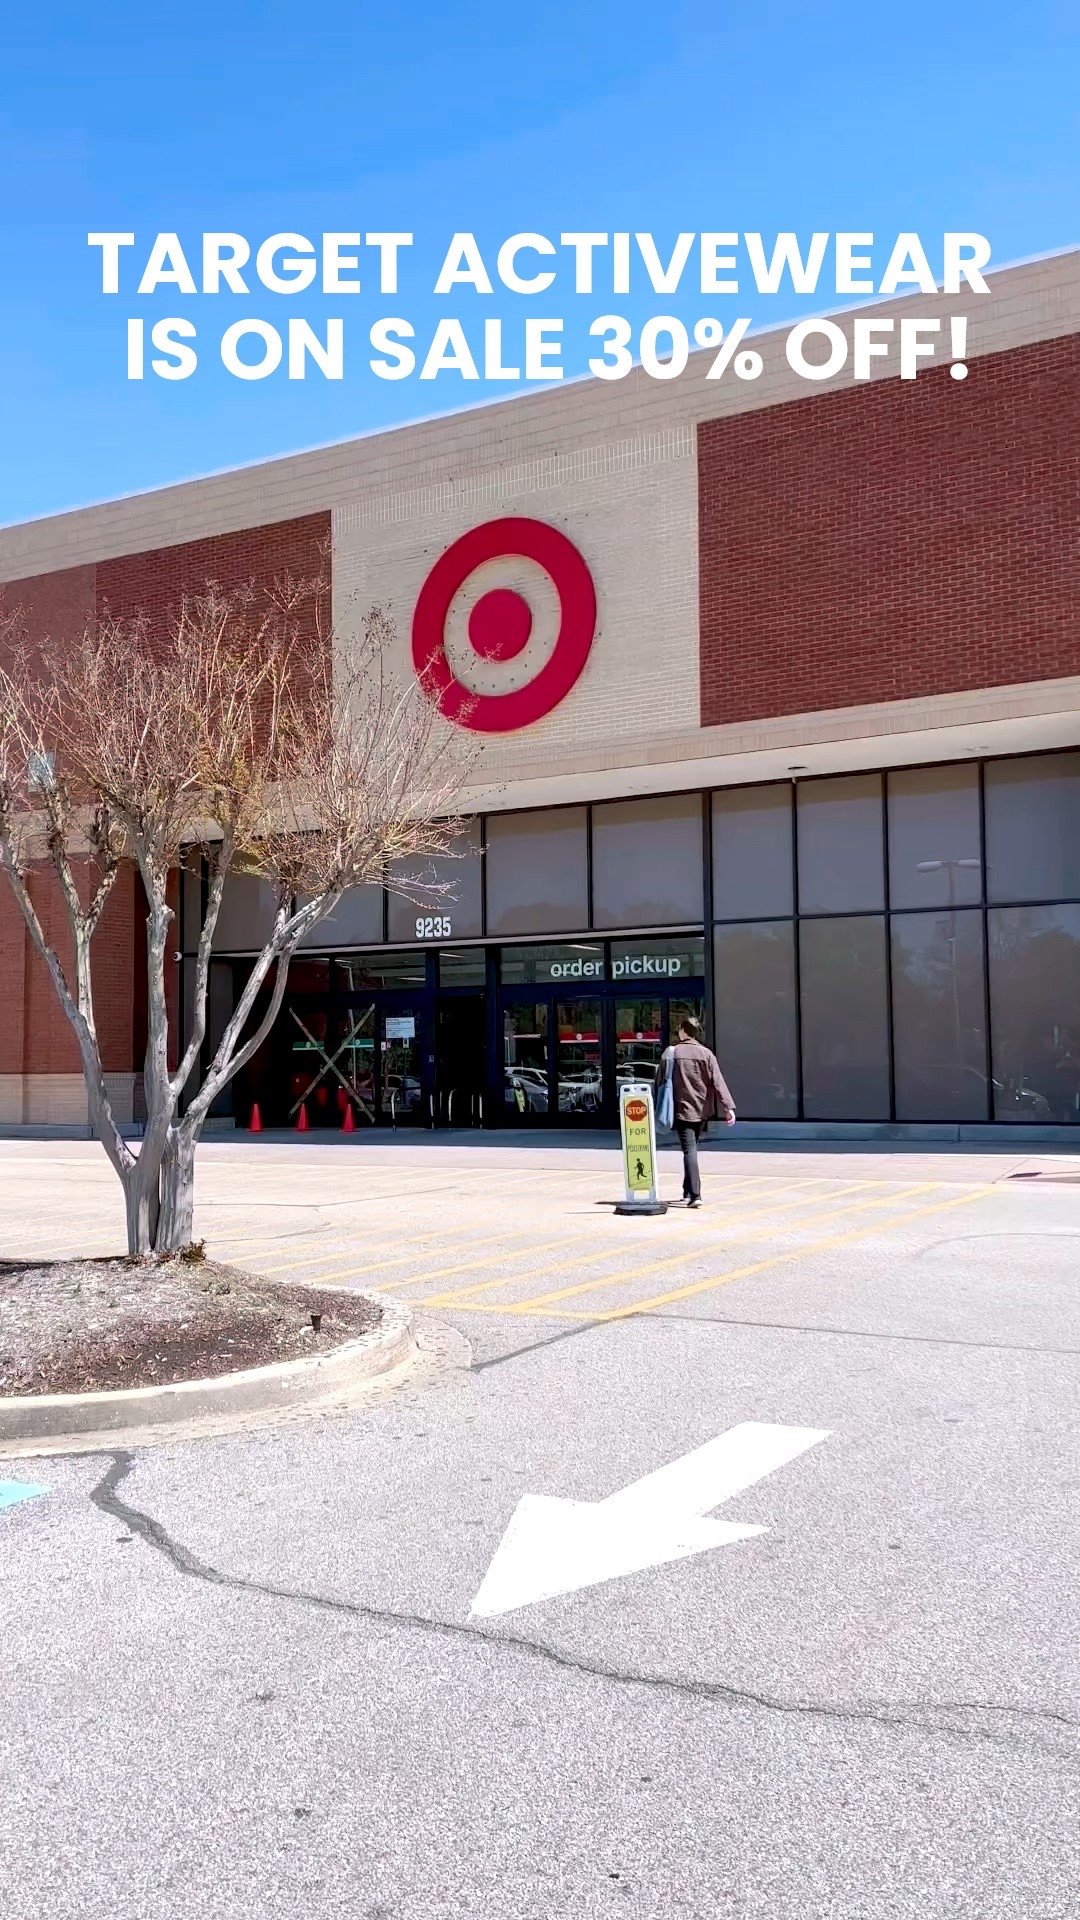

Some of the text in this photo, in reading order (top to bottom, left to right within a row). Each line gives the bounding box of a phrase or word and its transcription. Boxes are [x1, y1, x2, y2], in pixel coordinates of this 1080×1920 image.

[415, 916, 452, 938] 9235
[550, 955, 681, 979] order pickup
[626, 1106, 647, 1115] STOP
[629, 1127, 647, 1136] FOR
